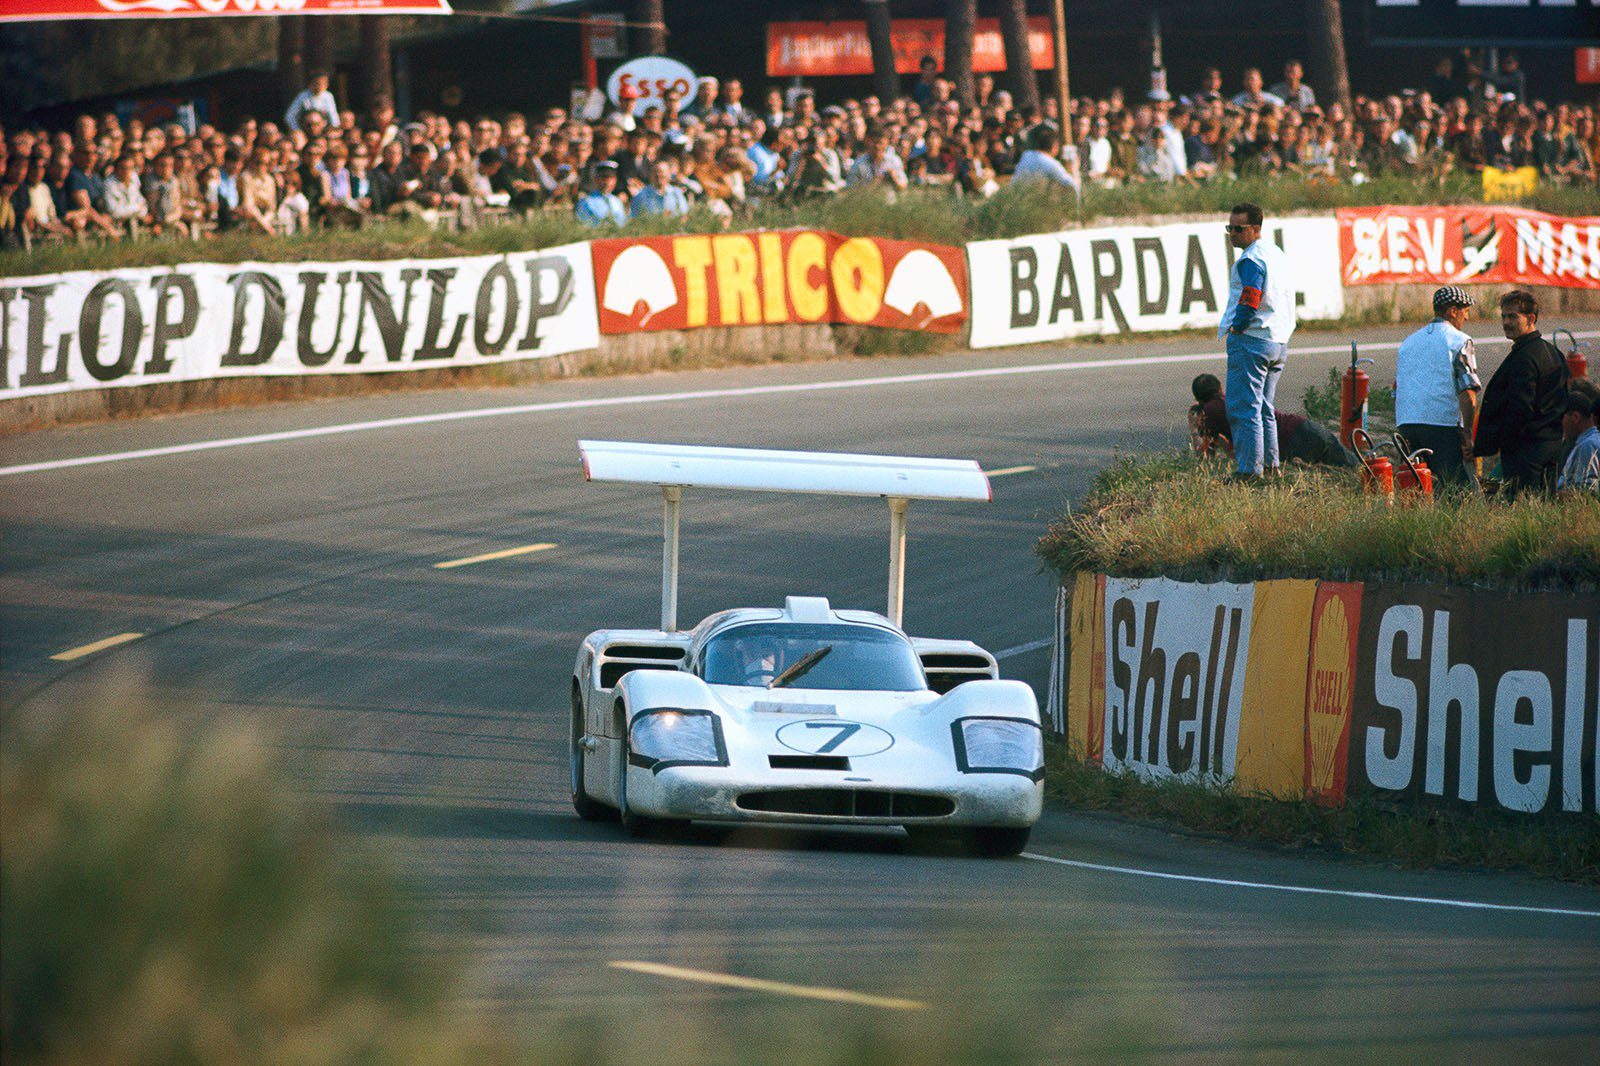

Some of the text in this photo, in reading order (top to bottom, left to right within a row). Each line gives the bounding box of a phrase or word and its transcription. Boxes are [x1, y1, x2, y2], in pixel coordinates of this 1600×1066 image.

[673, 231, 885, 327] TRICO
[1009, 228, 1305, 332] BARDA
[1353, 216, 1456, 275] S.E.V.
[220, 255, 576, 368] DUNLOP
[1111, 597, 1243, 775] Shell
[1313, 669, 1344, 716] SHELL
[1365, 604, 1600, 814] Shel
[805, 723, 861, 753] 7
